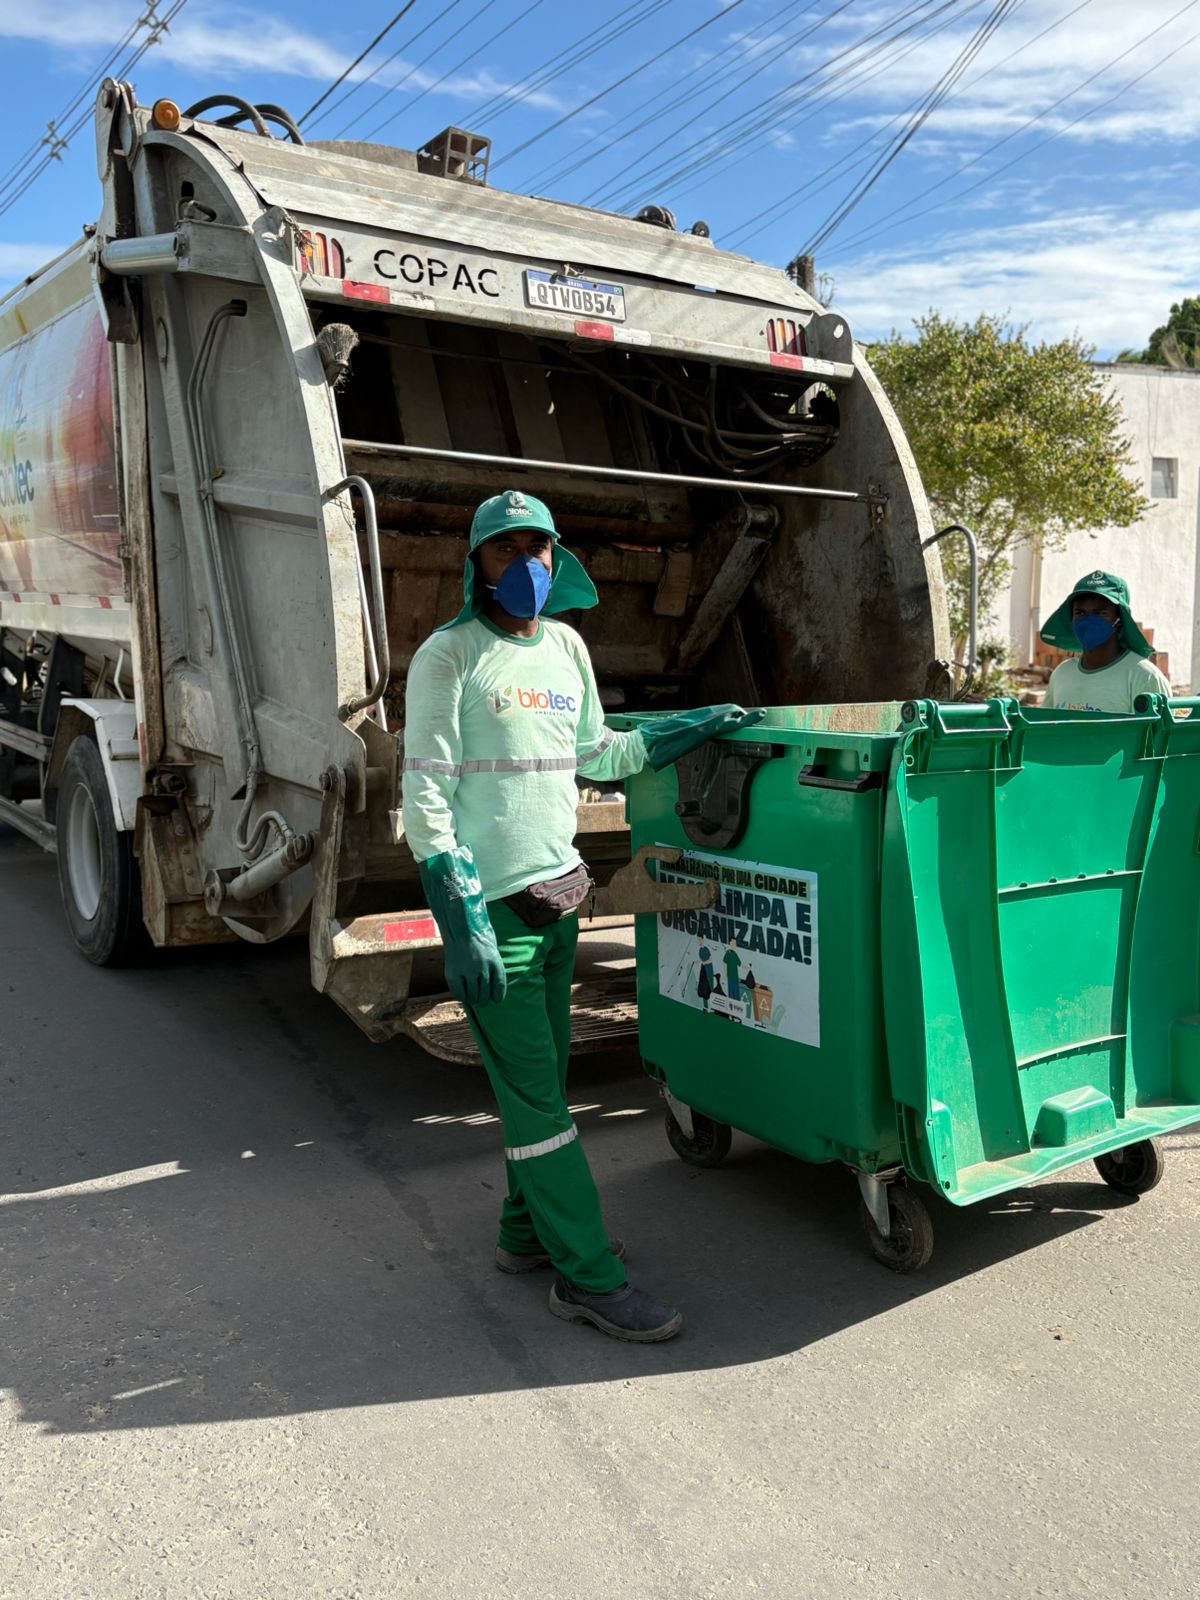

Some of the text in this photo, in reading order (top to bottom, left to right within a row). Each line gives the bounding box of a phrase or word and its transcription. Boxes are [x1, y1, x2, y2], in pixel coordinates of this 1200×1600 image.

[373, 249, 500, 297] COPAC
[537, 283, 616, 316] QTW0B54
[517, 687, 577, 713] biotec
[754, 873, 807, 898] CIDADE
[714, 887, 812, 933] LIMPA E
[660, 909, 812, 965] ORGANIZADA!
